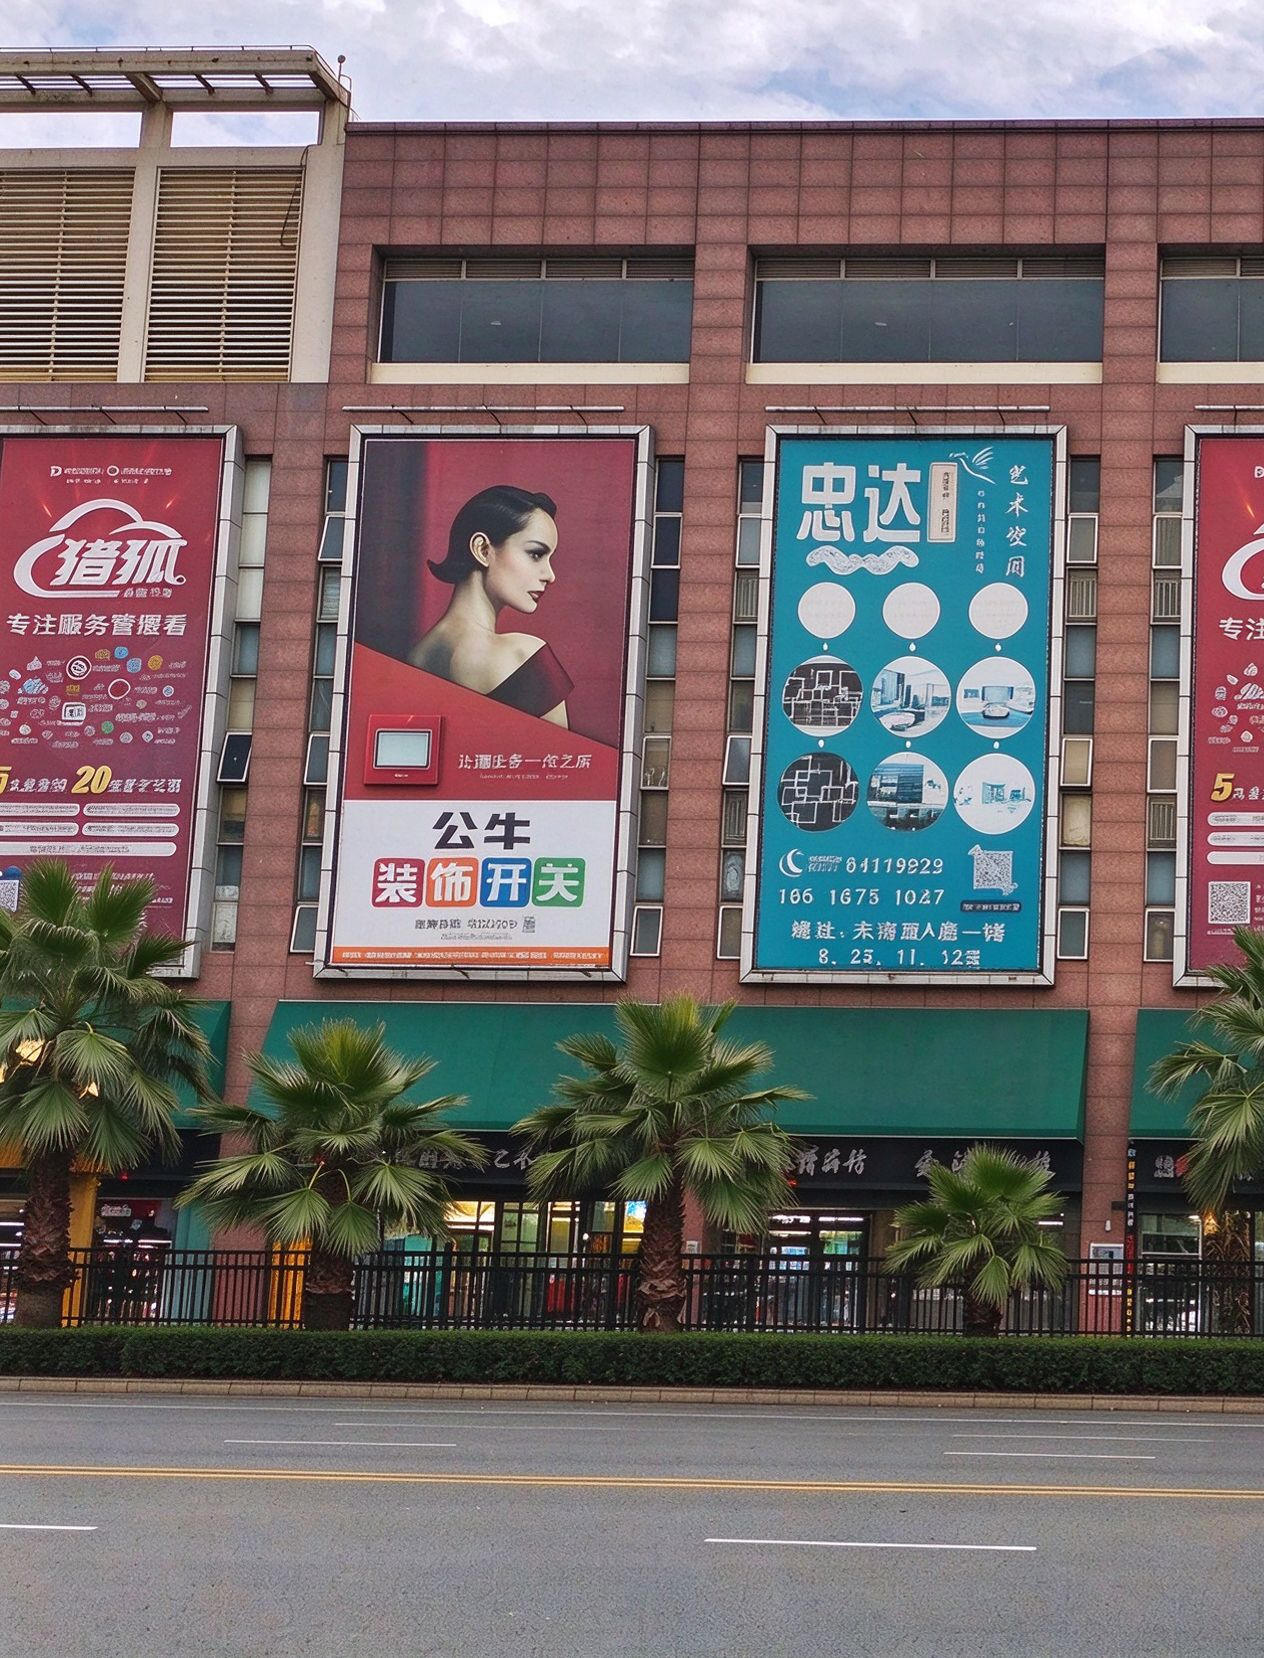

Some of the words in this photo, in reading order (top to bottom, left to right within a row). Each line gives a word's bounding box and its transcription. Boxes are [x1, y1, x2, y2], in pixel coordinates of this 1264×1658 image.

[796, 461, 921, 543] 忠达
[432, 812, 531, 849] 公牛
[374, 862, 580, 903] 装饰开关
